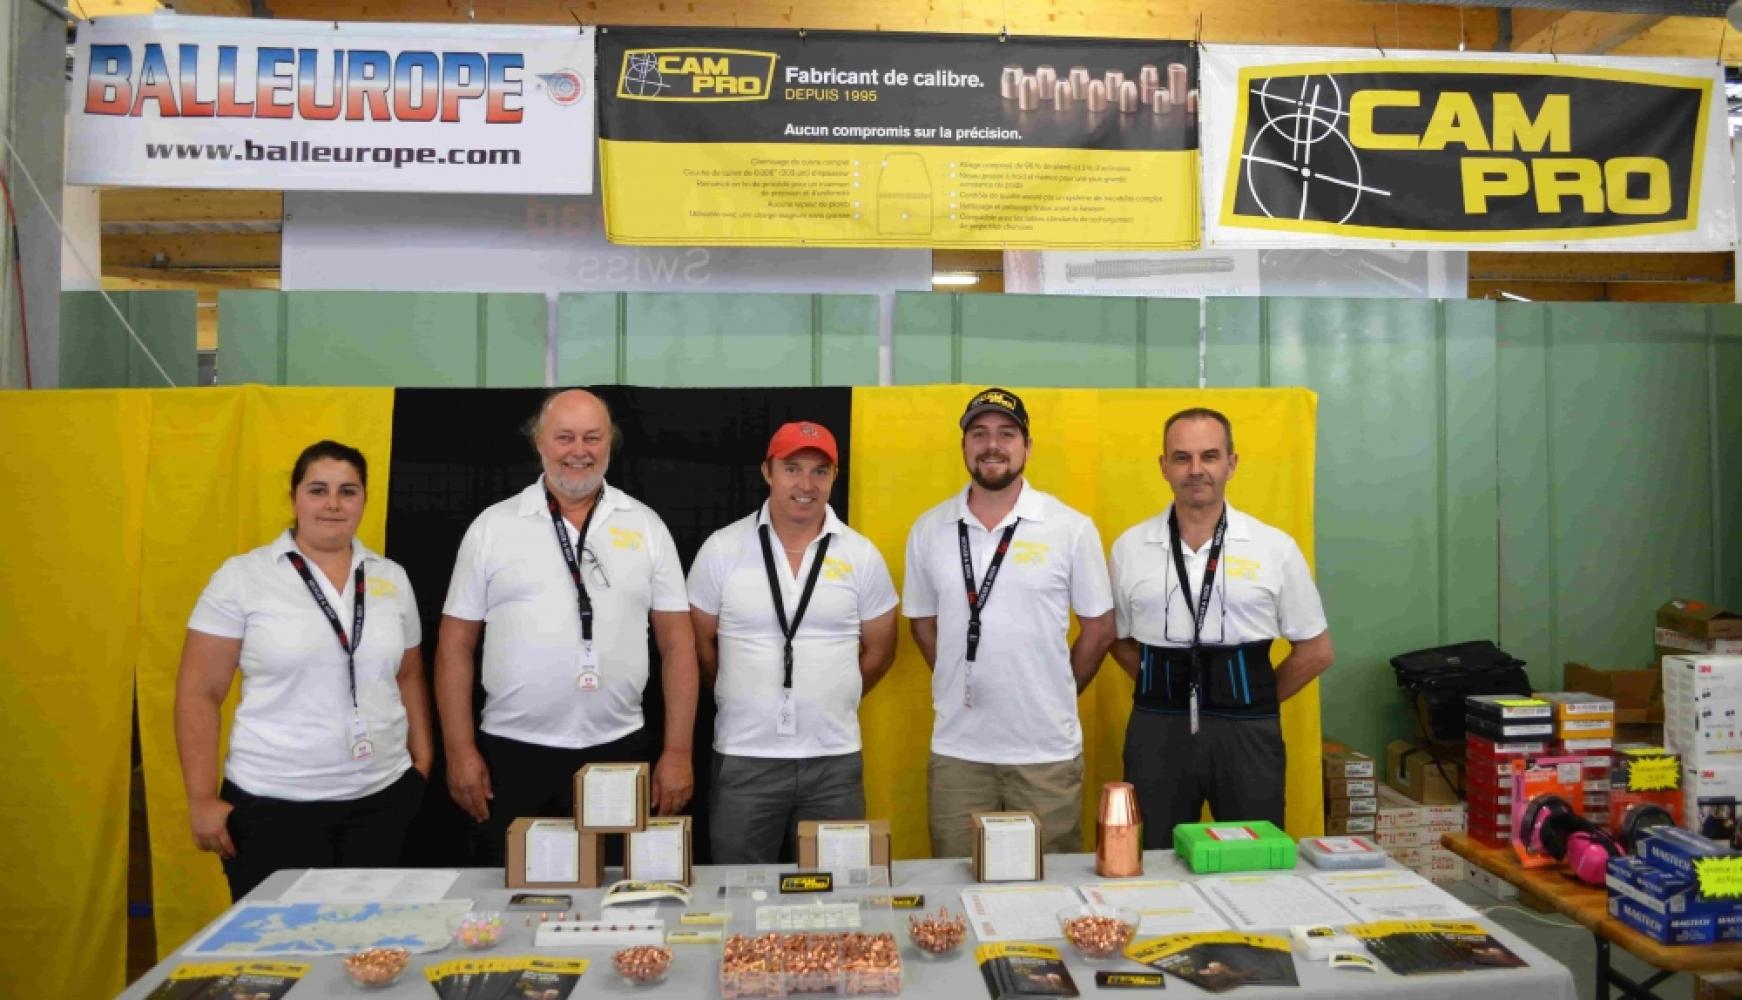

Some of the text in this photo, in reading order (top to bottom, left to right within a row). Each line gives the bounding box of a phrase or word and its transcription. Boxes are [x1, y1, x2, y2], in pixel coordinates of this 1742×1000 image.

[657, 55, 729, 76] CAM
[84, 43, 524, 124] BALLEUROPE
[693, 76, 761, 95] PRO
[785, 66, 985, 88] Fabricant de calibre.
[785, 88, 878, 102] DEPUIS 1995
[1348, 89, 1571, 153] CAM
[784, 123, 1023, 142] Aucun compromis sur la précision.
[146, 139, 522, 167] www.balleurope.com
[1459, 156, 1671, 215] PRO
